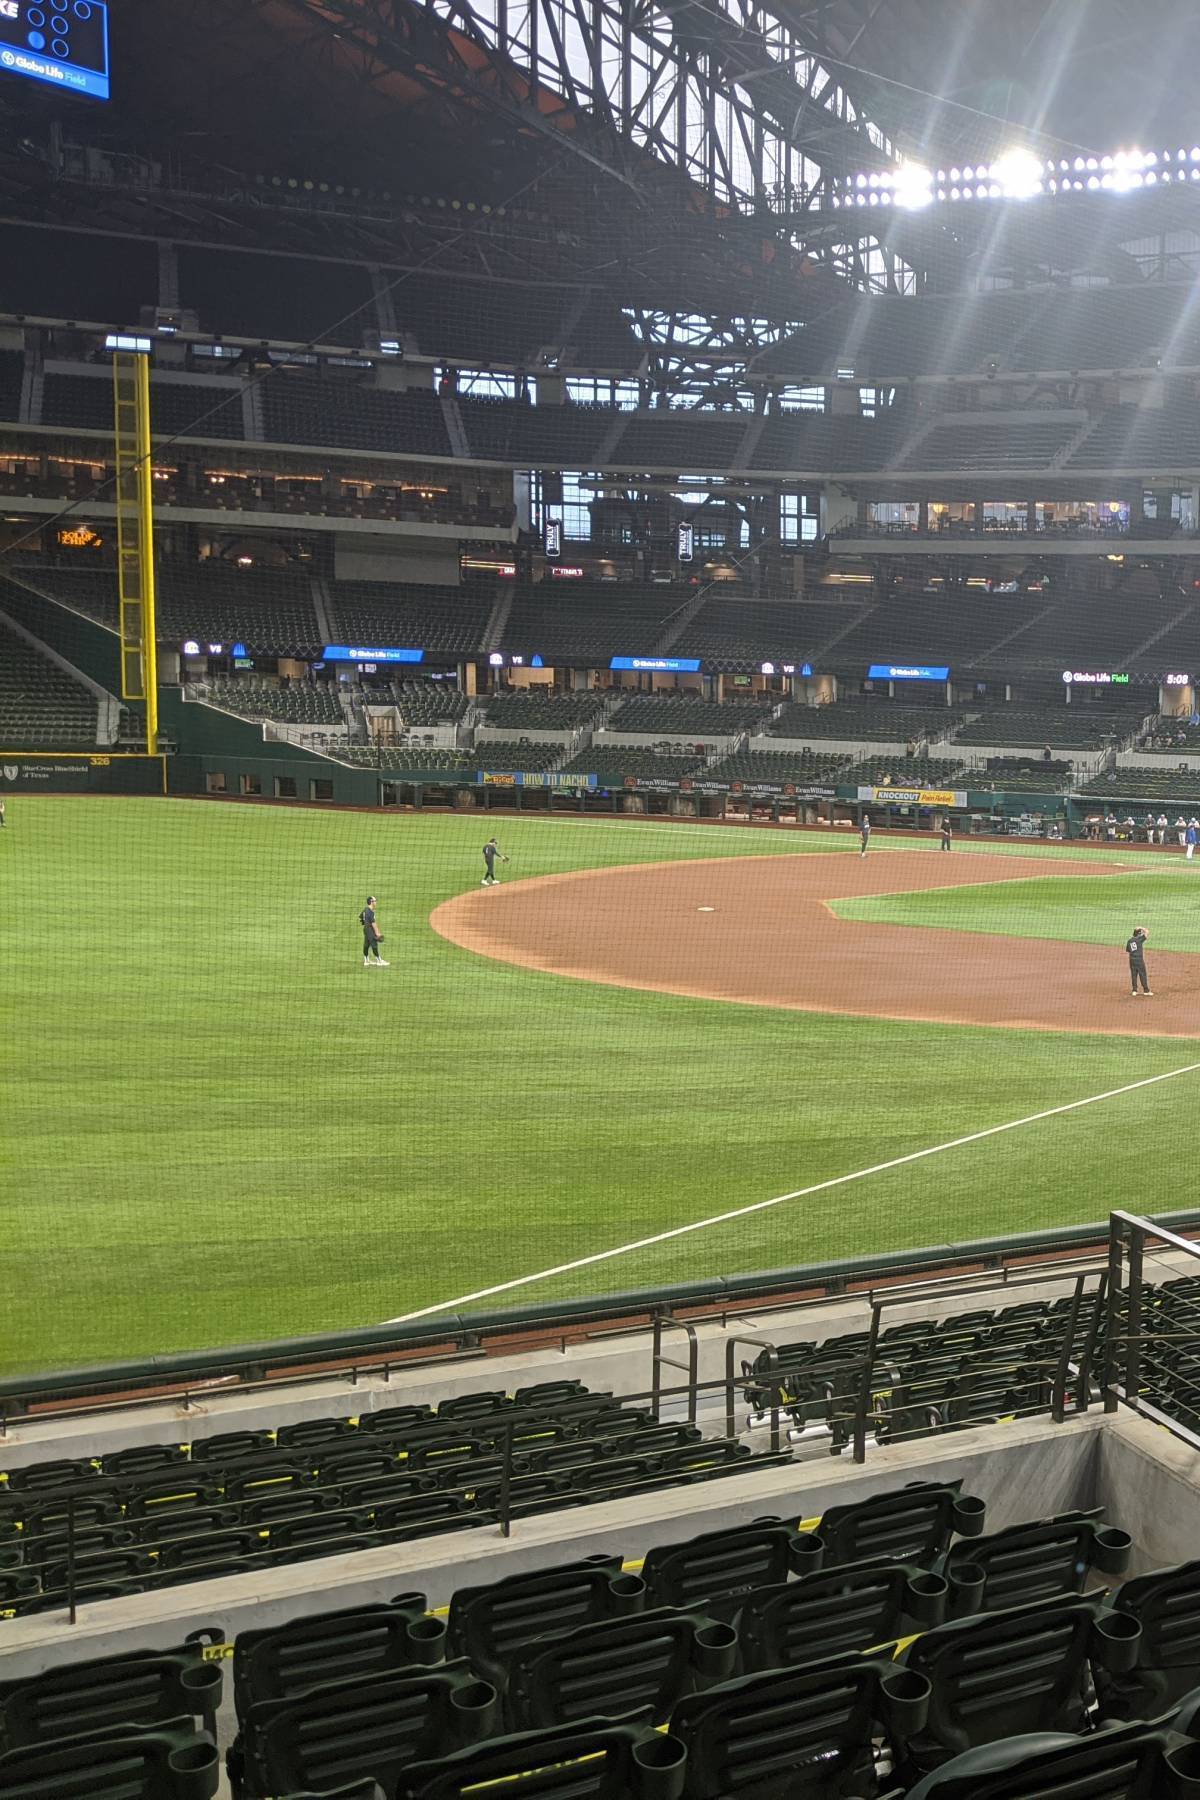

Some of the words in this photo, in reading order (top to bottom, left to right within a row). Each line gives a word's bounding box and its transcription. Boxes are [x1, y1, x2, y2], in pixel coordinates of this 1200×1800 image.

[15, 57, 45, 74] Globe
[45, 65, 64, 79] Life
[64, 71, 87, 87] Field
[546, 524, 554, 550] TRULY
[1073, 672, 1096, 682] Globe
[1096, 673, 1111, 683] Life
[1111, 674, 1129, 683] Field
[1166, 674, 1189, 684] 5:08
[89, 757, 111, 766] 326
[523, 773, 545, 785] HOW
[546, 774, 558, 786] TO
[560, 774, 589, 787] NACHO
[878, 791, 920, 800] KNOCKOUT
